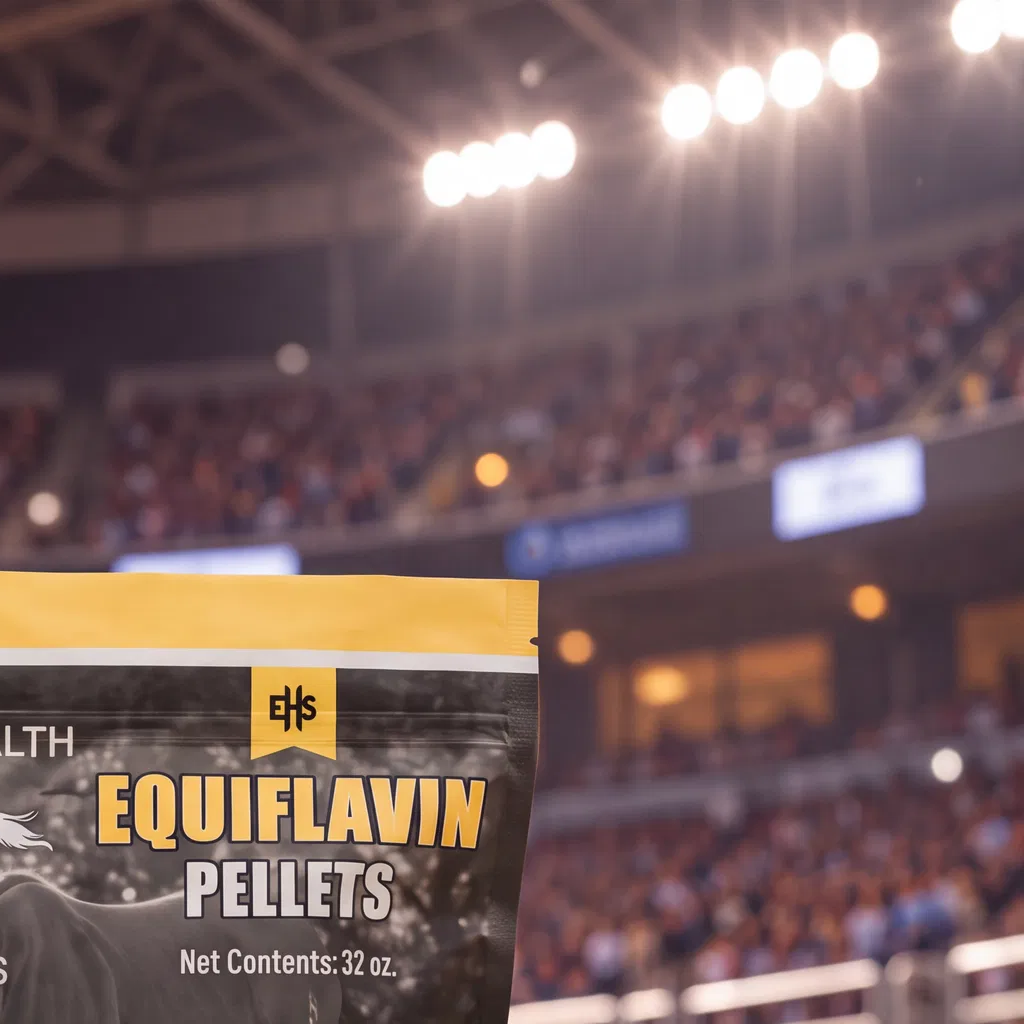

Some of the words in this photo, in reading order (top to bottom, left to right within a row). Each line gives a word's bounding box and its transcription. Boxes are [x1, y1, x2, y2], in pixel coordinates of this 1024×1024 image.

[269, 685, 317, 732] EHS
[96, 773, 487, 850] EQUIFLAVIN
[184, 860, 393, 920] PELLETS
[180, 948, 221, 975] Net
[227, 948, 338, 976] Contents:
[341, 949, 365, 976] 32
[369, 957, 397, 977] oz.
